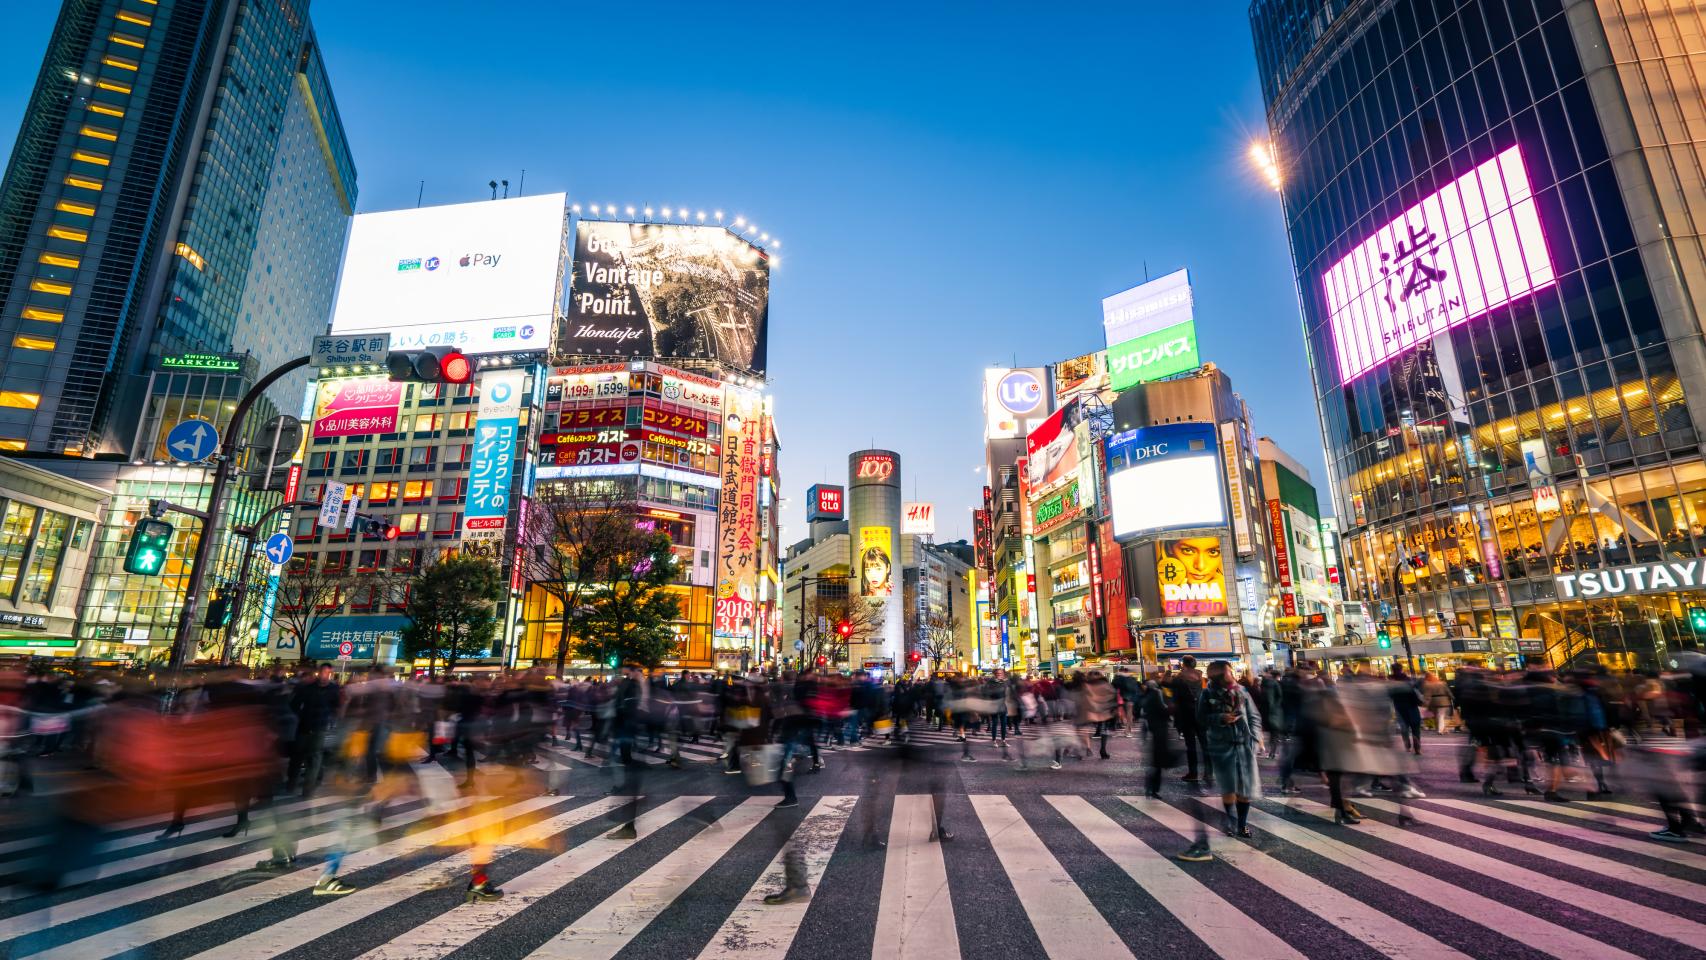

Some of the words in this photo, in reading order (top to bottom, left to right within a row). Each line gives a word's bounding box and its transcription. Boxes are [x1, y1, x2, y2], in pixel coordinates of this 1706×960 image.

[473, 253, 502, 268] Pay
[585, 262, 664, 288] Vantage
[581, 292, 637, 317] Point.
[1383, 296, 1461, 344] SHIBUTAN
[574, 324, 644, 344] HondaJet
[318, 338, 384, 354] 渋谷駅前
[164, 357, 203, 366] MARK
[184, 353, 221, 361] SHIBUYA
[326, 355, 357, 364] Shibuya
[1111, 336, 1191, 375] サロンパス
[548, 385, 562, 394] 9F
[564, 385, 594, 399] 1,199円
[596, 383, 628, 396] 1,599円
[683, 387, 721, 407] しゃぶ葉
[1001, 383, 1036, 404] UC
[354, 393, 393, 404] クリニック
[325, 416, 393, 432] 品川美容外科
[560, 410, 625, 425] プライス
[643, 409, 705, 433] コンタクト
[597, 431, 630, 443] ガスト
[686, 440, 716, 455] ガスト
[1135, 443, 1169, 460] DHC
[540, 452, 556, 463] 7F
[576, 448, 617, 465] ガスト
[472, 427, 498, 509] アイシティ
[491, 425, 513, 508] コンタクトの
[857, 460, 893, 482] 109
[737, 418, 758, 568] 打首獄門同好会が
[821, 492, 837, 501] UNI
[1231, 482, 1243, 520] neon
[721, 435, 742, 577] 日本武道館だって。
[821, 501, 839, 510] QLO
[907, 505, 931, 521] H&M
[1163, 582, 1223, 601] DMM
[717, 600, 753, 619] 2018
[1165, 600, 1223, 614] Bitcoin
